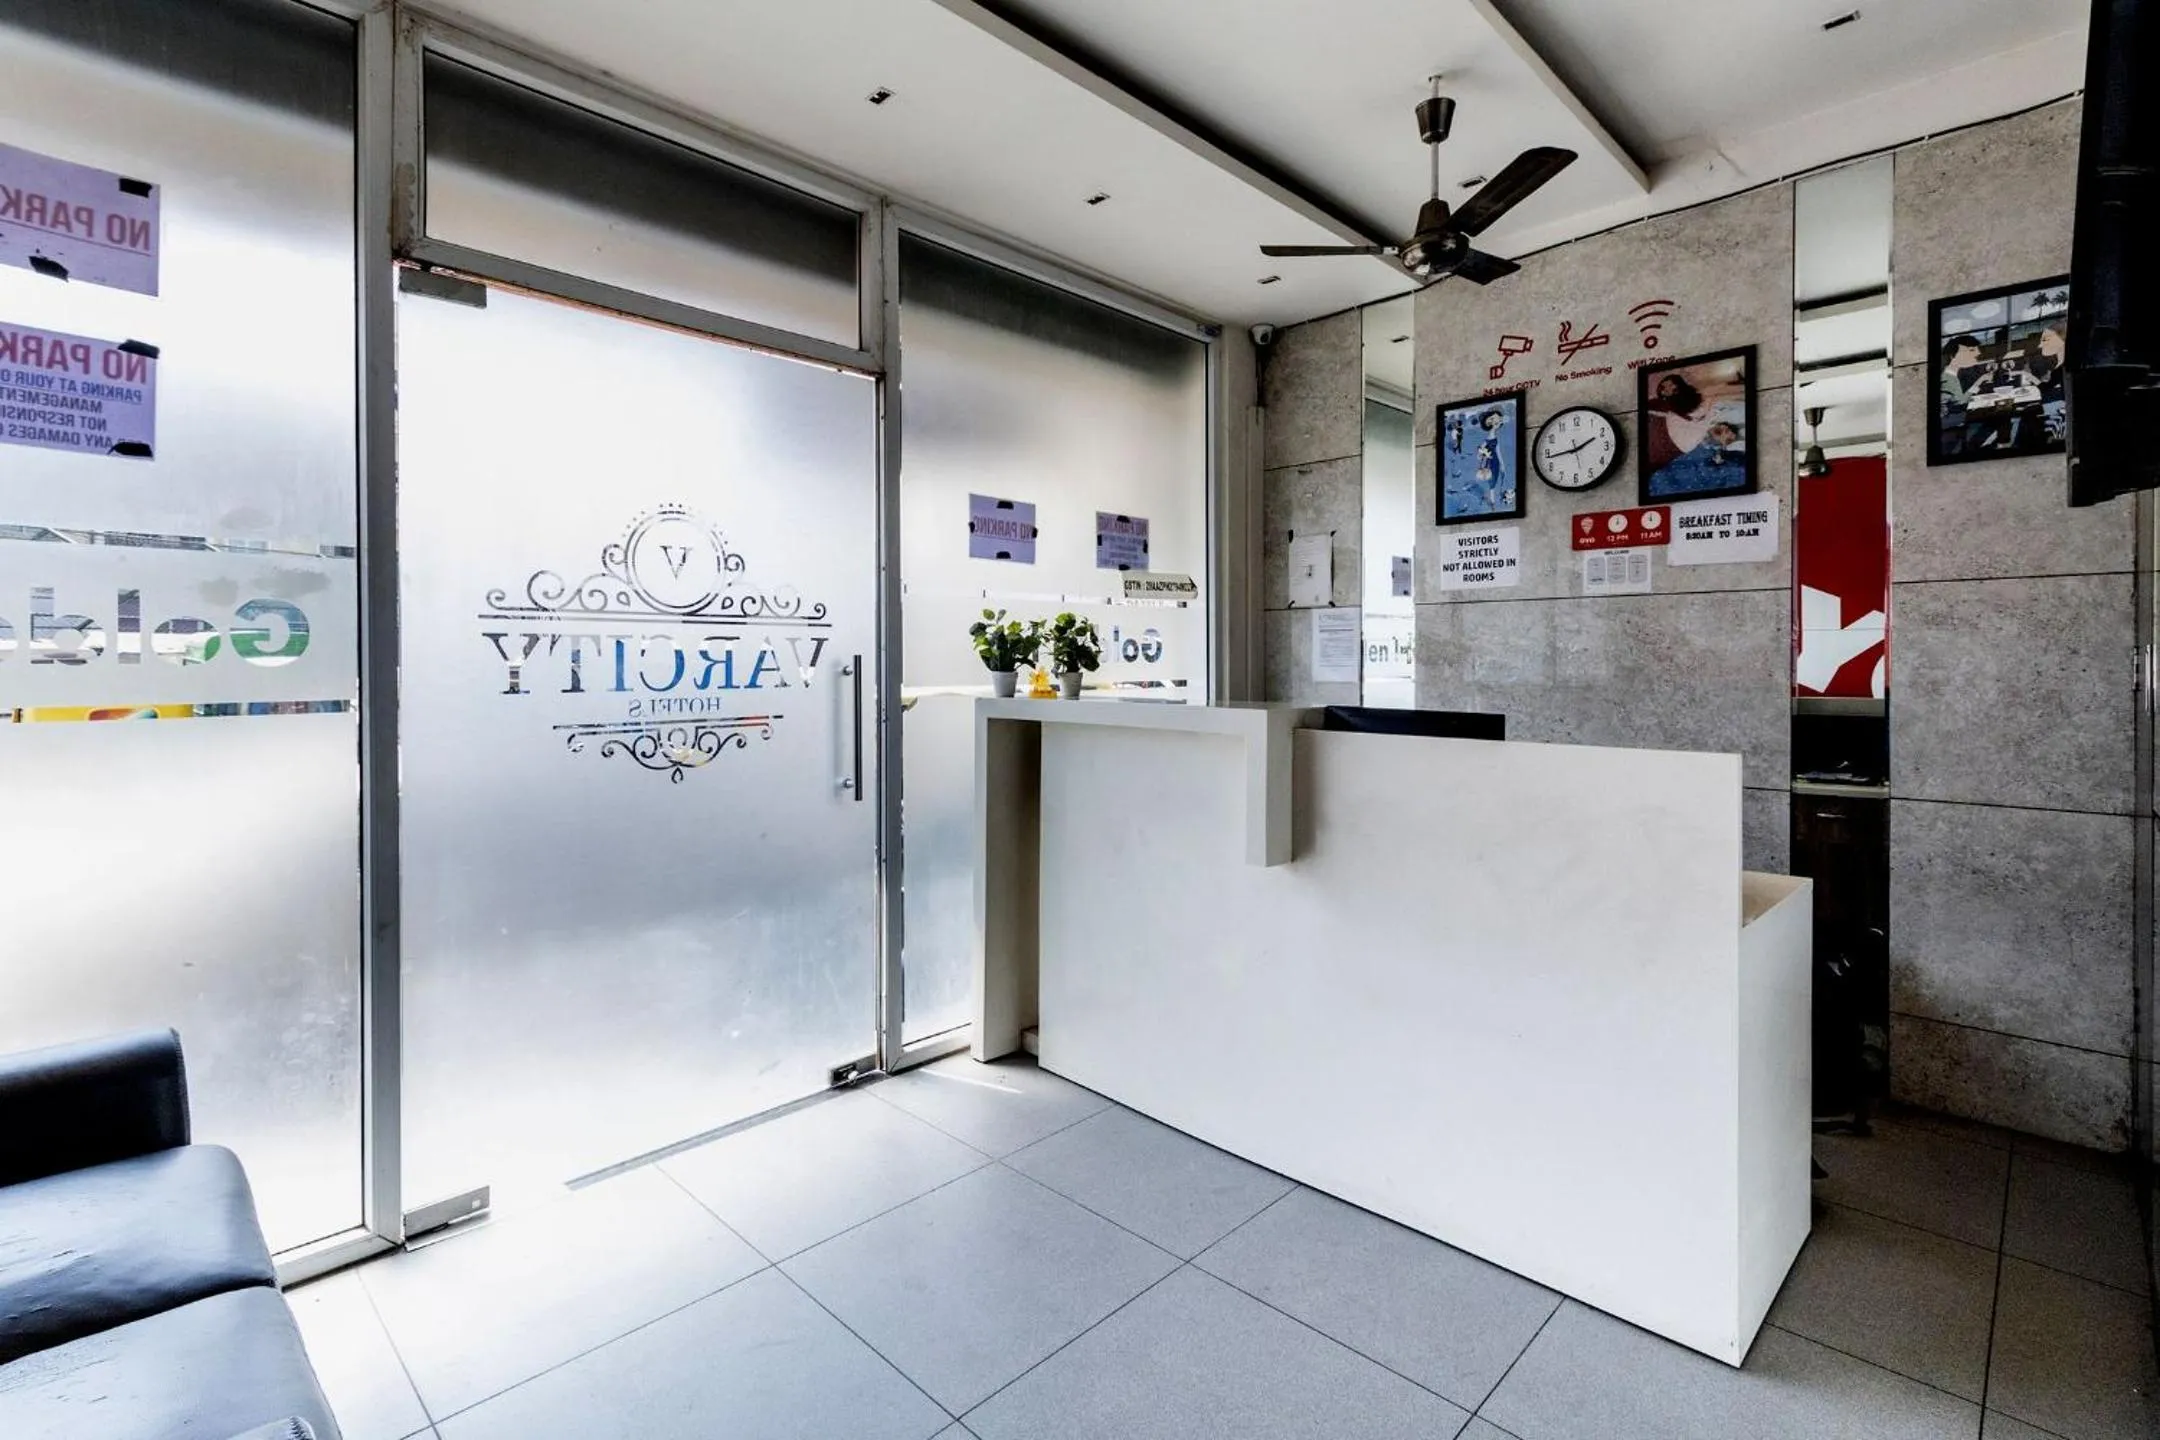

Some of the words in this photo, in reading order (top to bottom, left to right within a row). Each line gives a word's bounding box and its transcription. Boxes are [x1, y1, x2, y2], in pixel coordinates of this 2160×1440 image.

[1555, 374, 1569, 382] No
[1570, 366, 1612, 379] Smoking
[1515, 379, 1541, 390] CCTV
[1679, 513, 1732, 528] BREAKFAST
[1736, 511, 1767, 524] TIMING
[1458, 534, 1499, 546] VISITORS
[1719, 530, 1730, 538] TO
[1458, 547, 1499, 559] STRICTLY
[1443, 563, 1460, 572] NOT
[1462, 559, 1505, 571] ALLOWED
[1506, 558, 1516, 567] IN
[1463, 572, 1495, 582] ROOMS
